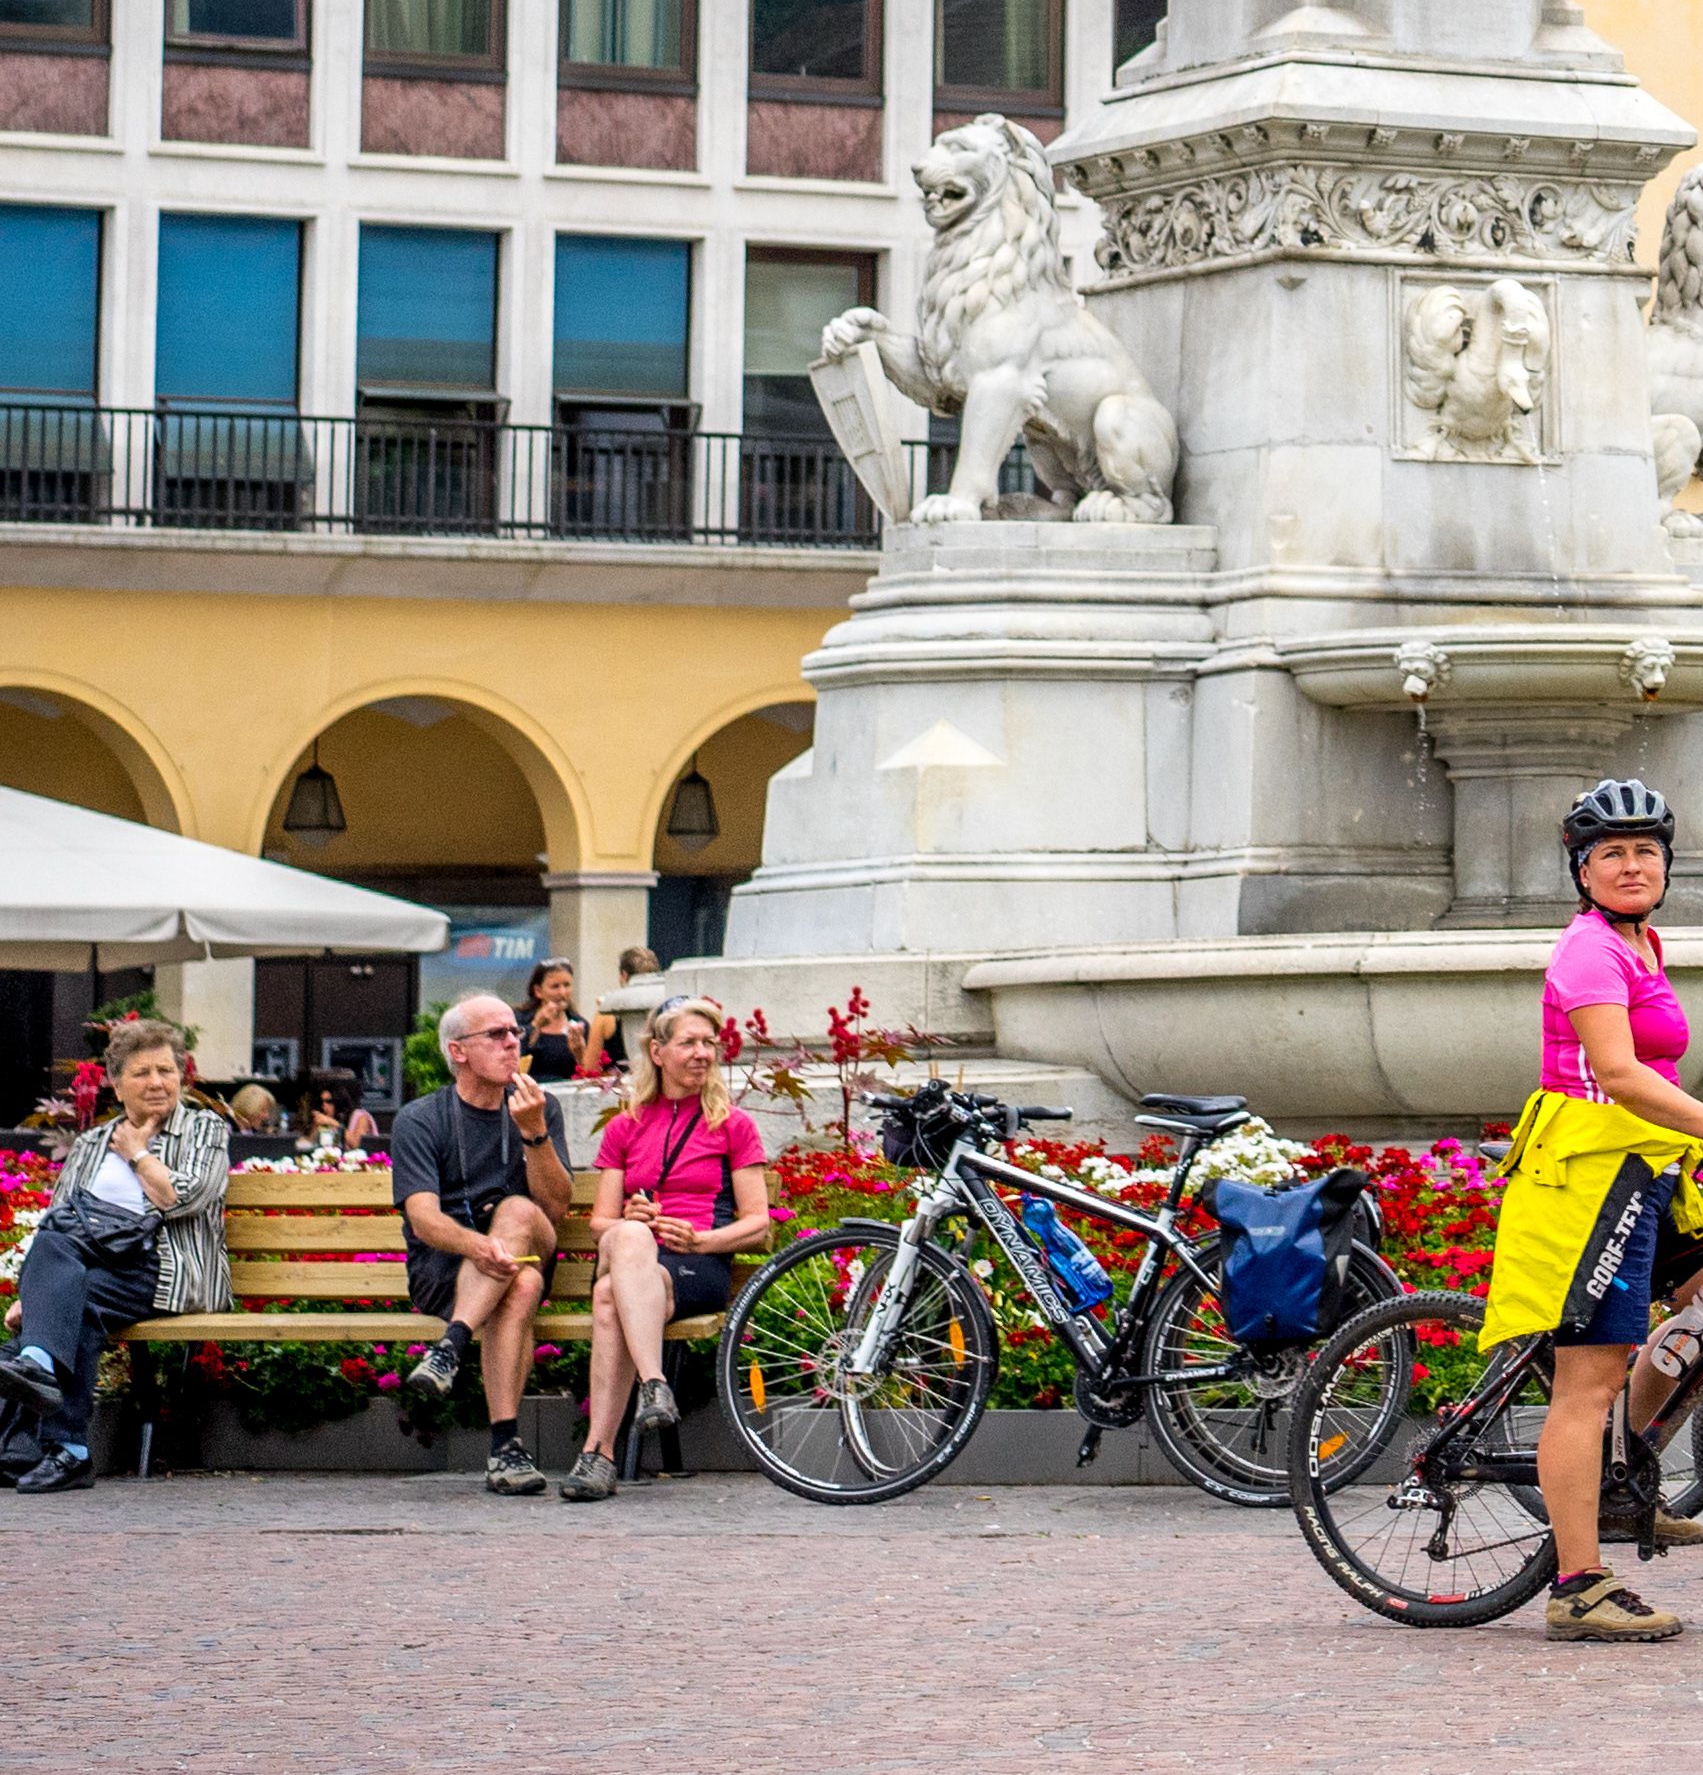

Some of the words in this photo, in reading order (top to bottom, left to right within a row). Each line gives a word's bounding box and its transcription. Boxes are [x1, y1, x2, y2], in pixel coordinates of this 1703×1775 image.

[495, 937, 535, 959] TIM
[980, 1197, 1070, 1324] DYNAMICS
[1302, 1505, 1340, 1559] RACING
[1336, 1561, 1384, 1598] RALPH
